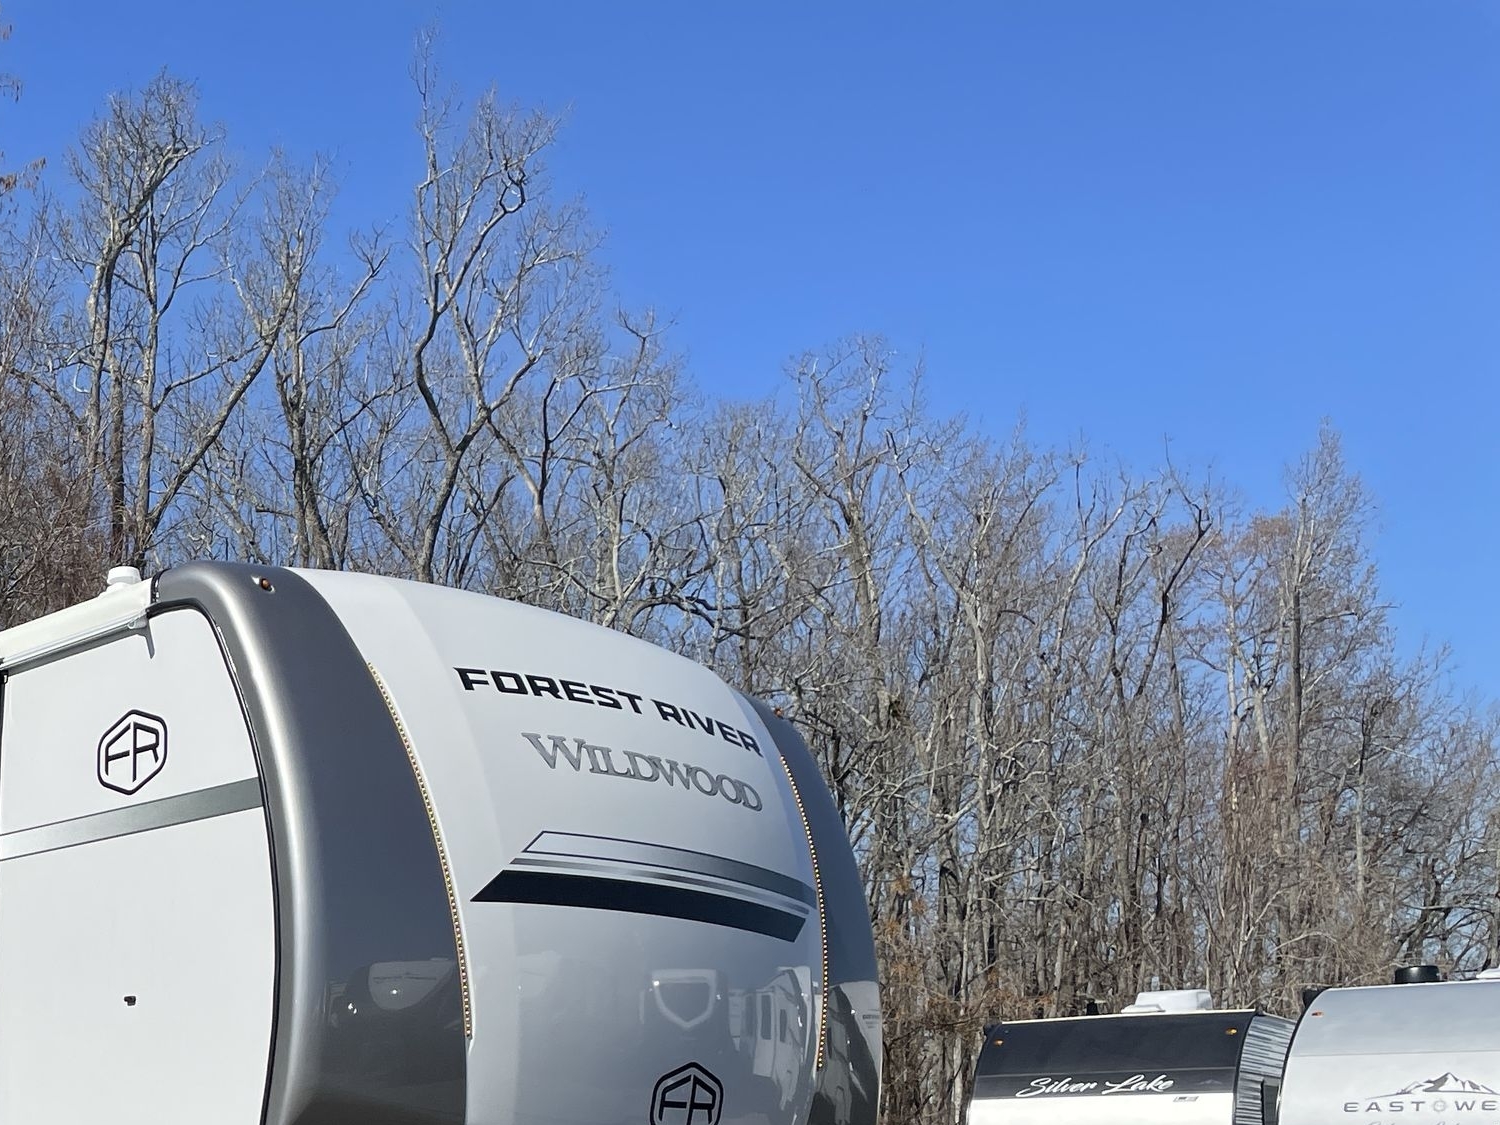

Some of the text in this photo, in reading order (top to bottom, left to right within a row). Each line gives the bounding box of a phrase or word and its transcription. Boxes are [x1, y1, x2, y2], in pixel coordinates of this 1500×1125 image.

[453, 667, 763, 758] FOREST RIVER
[521, 732, 763, 812] WILDWOOD
[1015, 1074, 1174, 1098] Silver Lake
